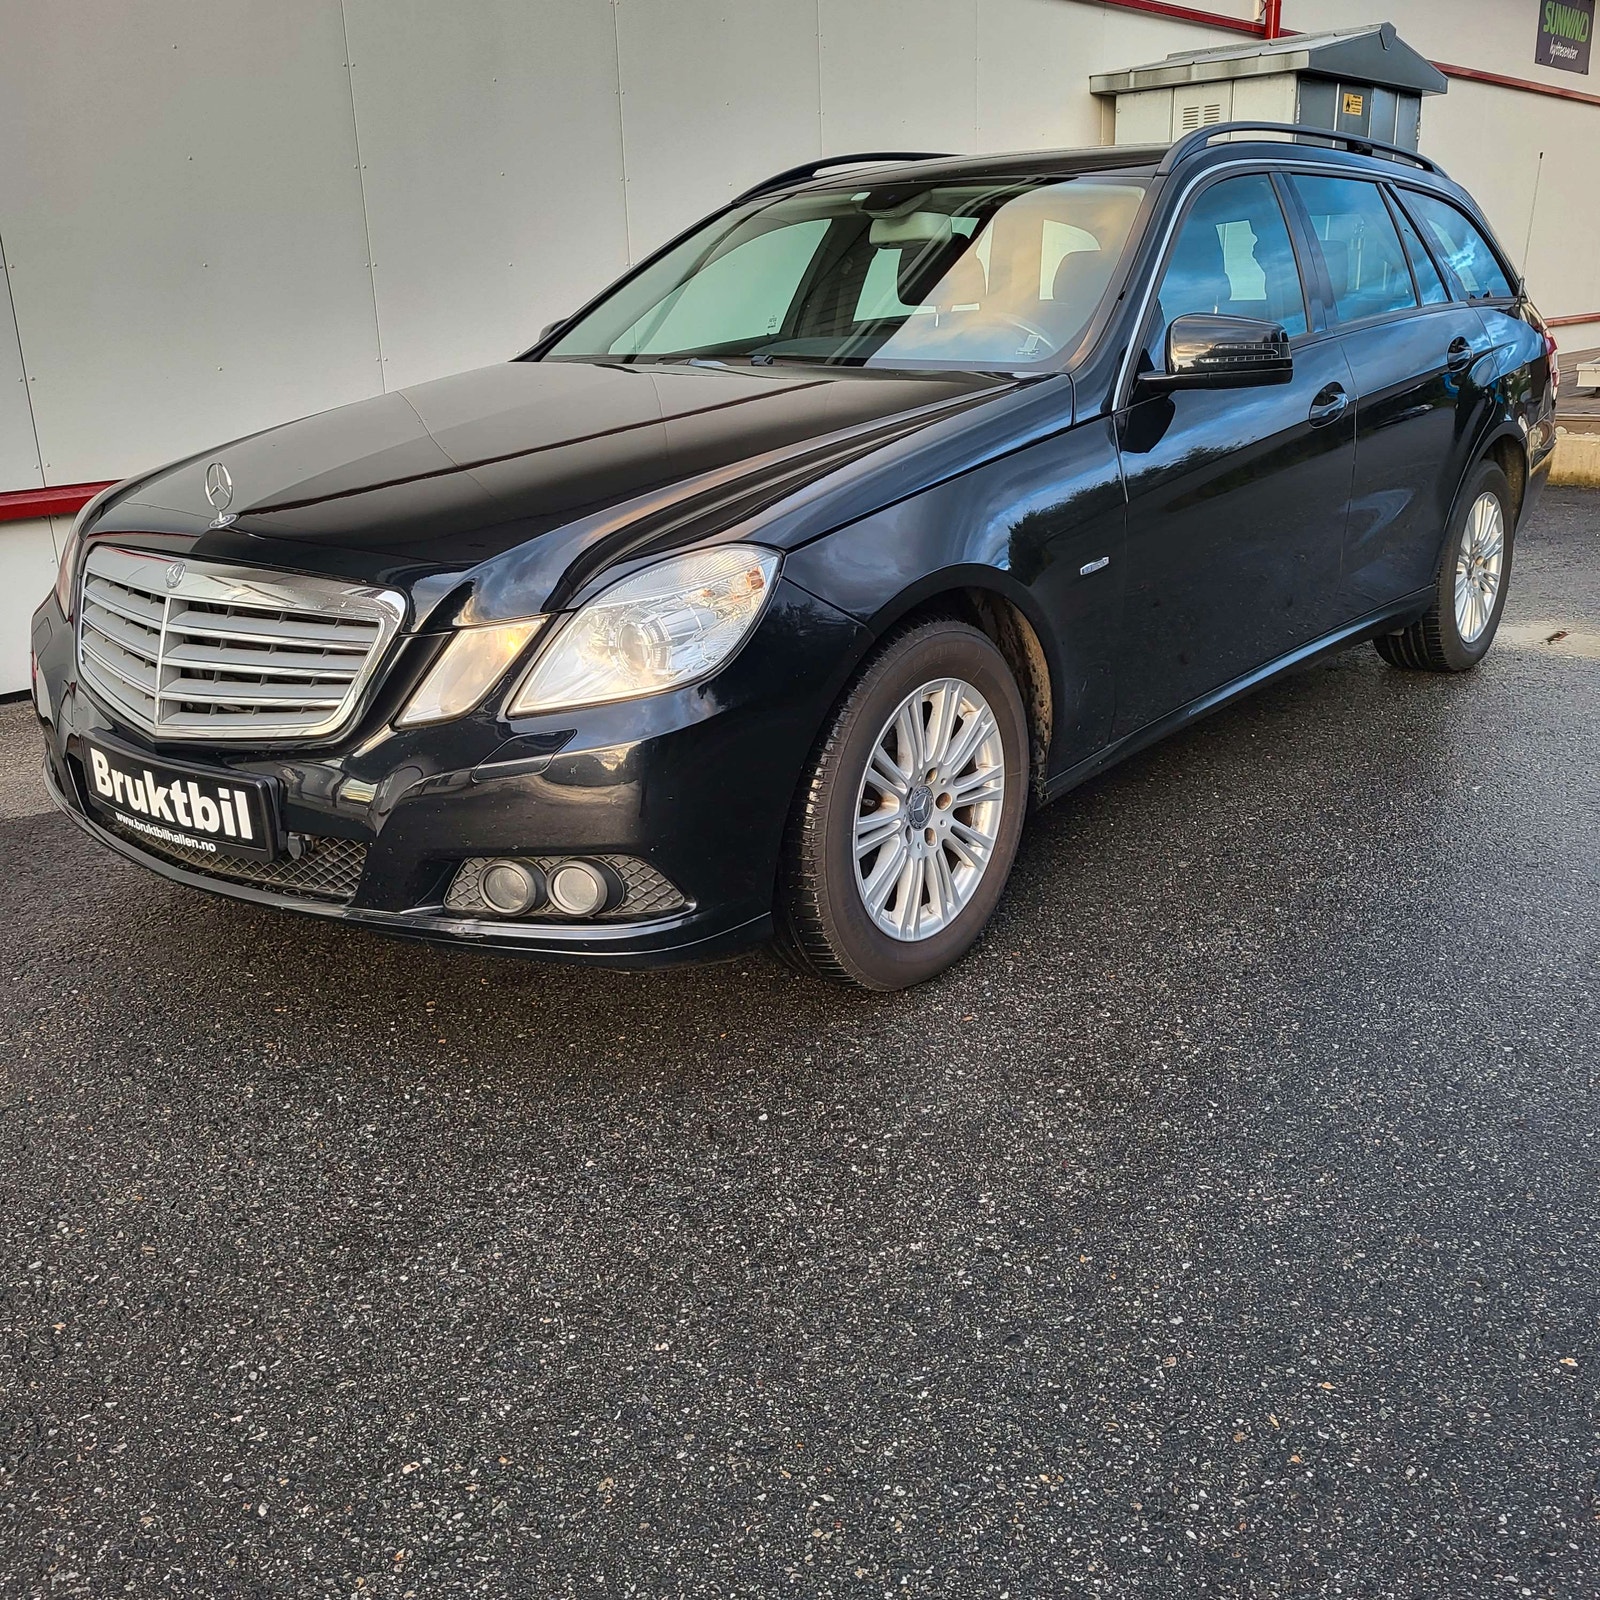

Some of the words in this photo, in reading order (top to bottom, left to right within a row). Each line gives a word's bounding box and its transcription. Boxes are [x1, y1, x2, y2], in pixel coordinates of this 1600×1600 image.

[1543, 1, 1589, 42] SUNWIND
[90, 747, 253, 840] Bruktbil
[115, 811, 217, 853] www.bruktbilhallen.no
